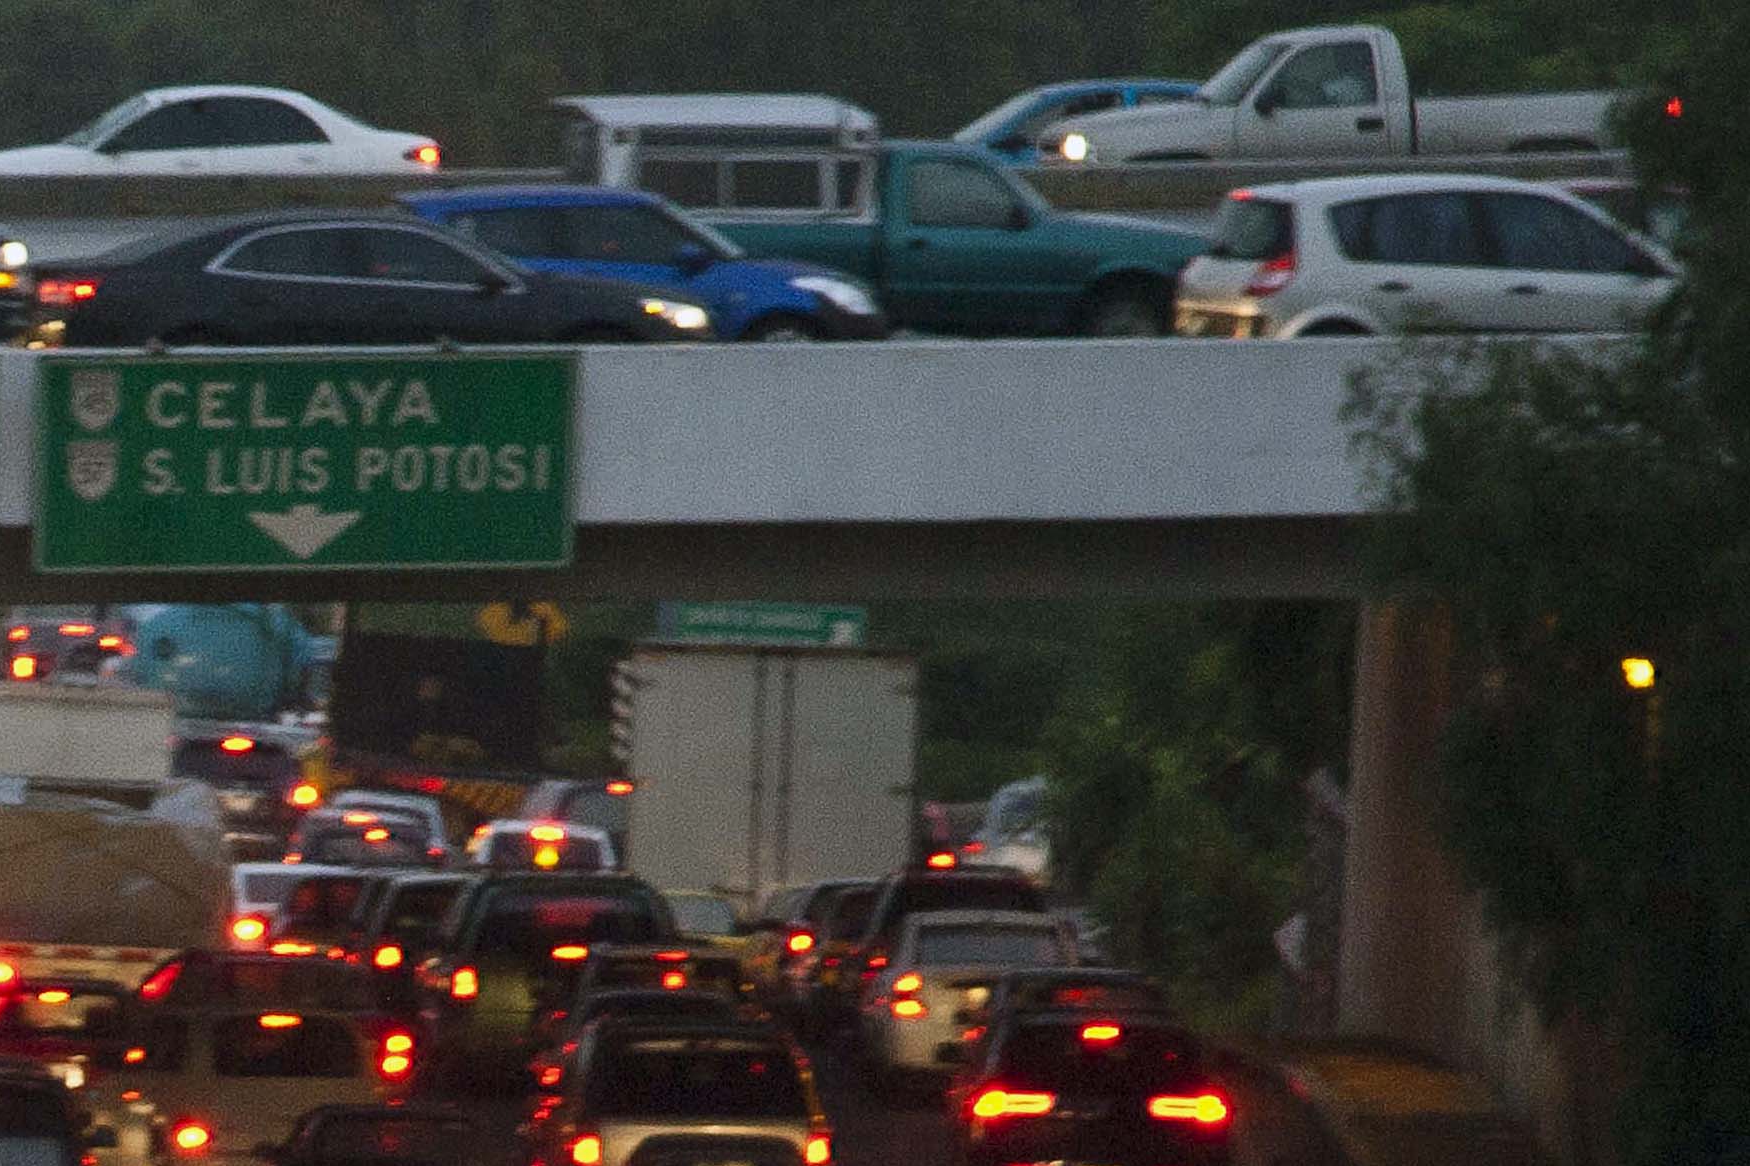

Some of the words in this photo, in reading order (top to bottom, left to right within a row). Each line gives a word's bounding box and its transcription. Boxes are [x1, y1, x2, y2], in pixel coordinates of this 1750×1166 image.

[145, 379, 438, 430] CELAYA
[205, 446, 330, 495] LUIS
[355, 443, 550, 492] POTOSI
